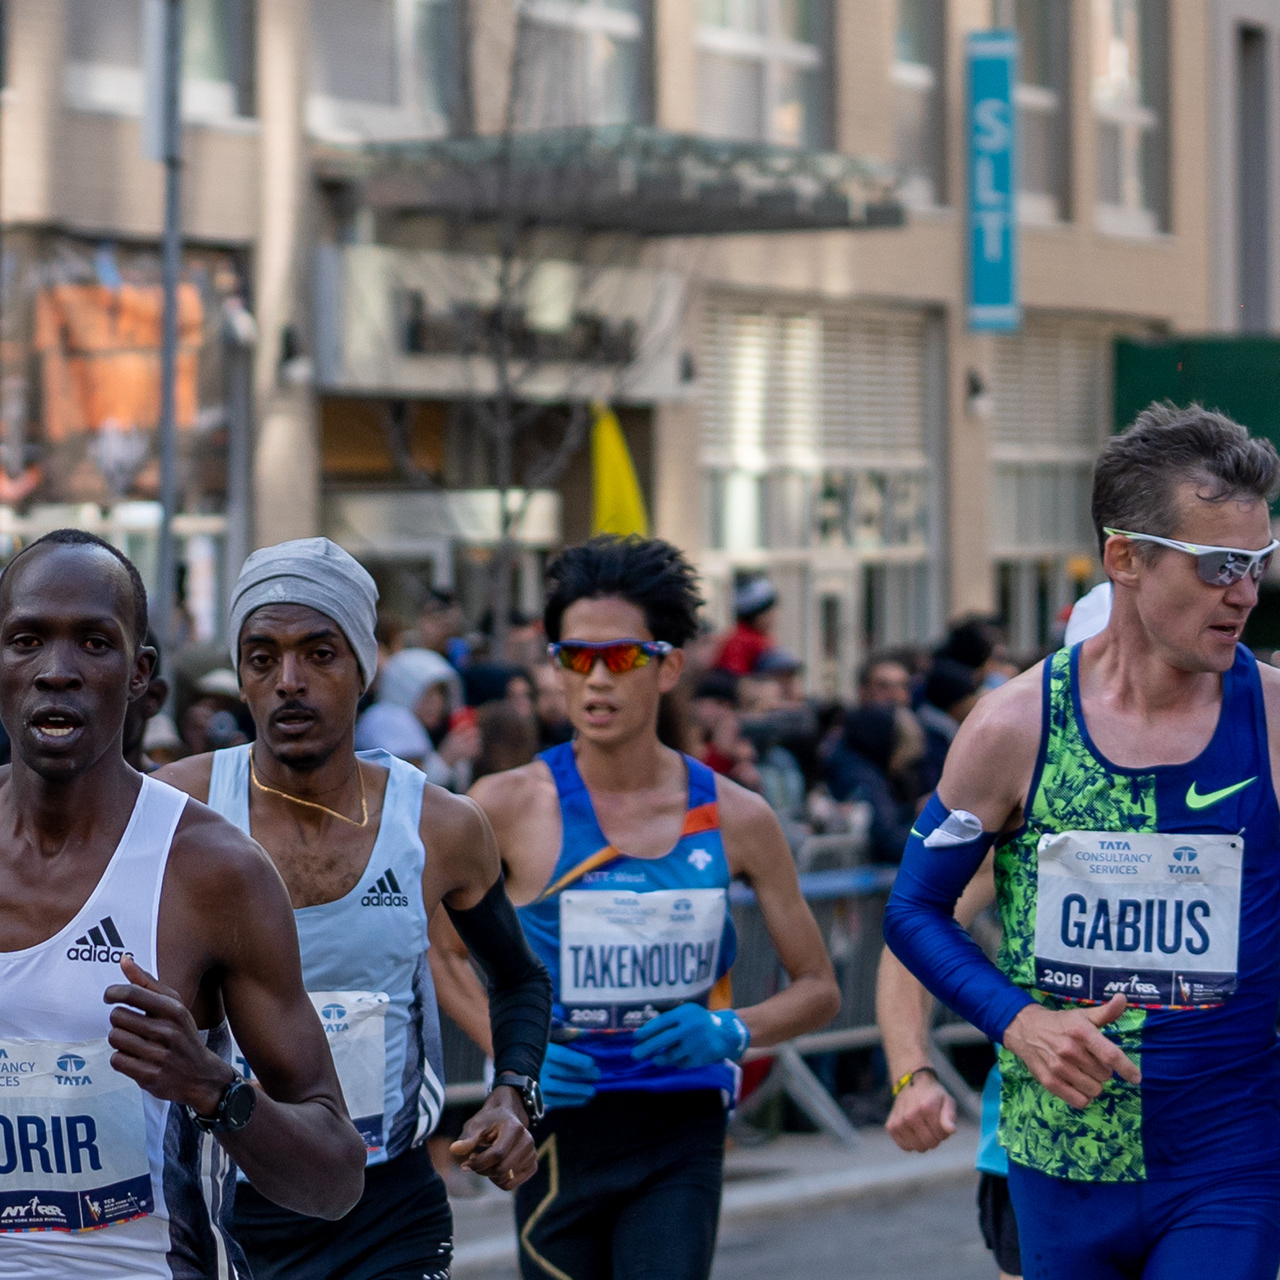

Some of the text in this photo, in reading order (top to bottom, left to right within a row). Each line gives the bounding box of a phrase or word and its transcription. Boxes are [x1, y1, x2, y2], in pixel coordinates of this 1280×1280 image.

[975, 99, 1010, 263] SLT
[1099, 841, 1131, 850] TATA
[1075, 851, 1152, 863] CONSULTANCY
[1089, 864, 1138, 875] SERVICES
[1168, 865, 1200, 875] TATA
[361, 892, 409, 907] adidas
[1060, 893, 1211, 955] GABIUS
[1043, 969, 1083, 988] 2019
[54, 1075, 93, 1086] TATA
